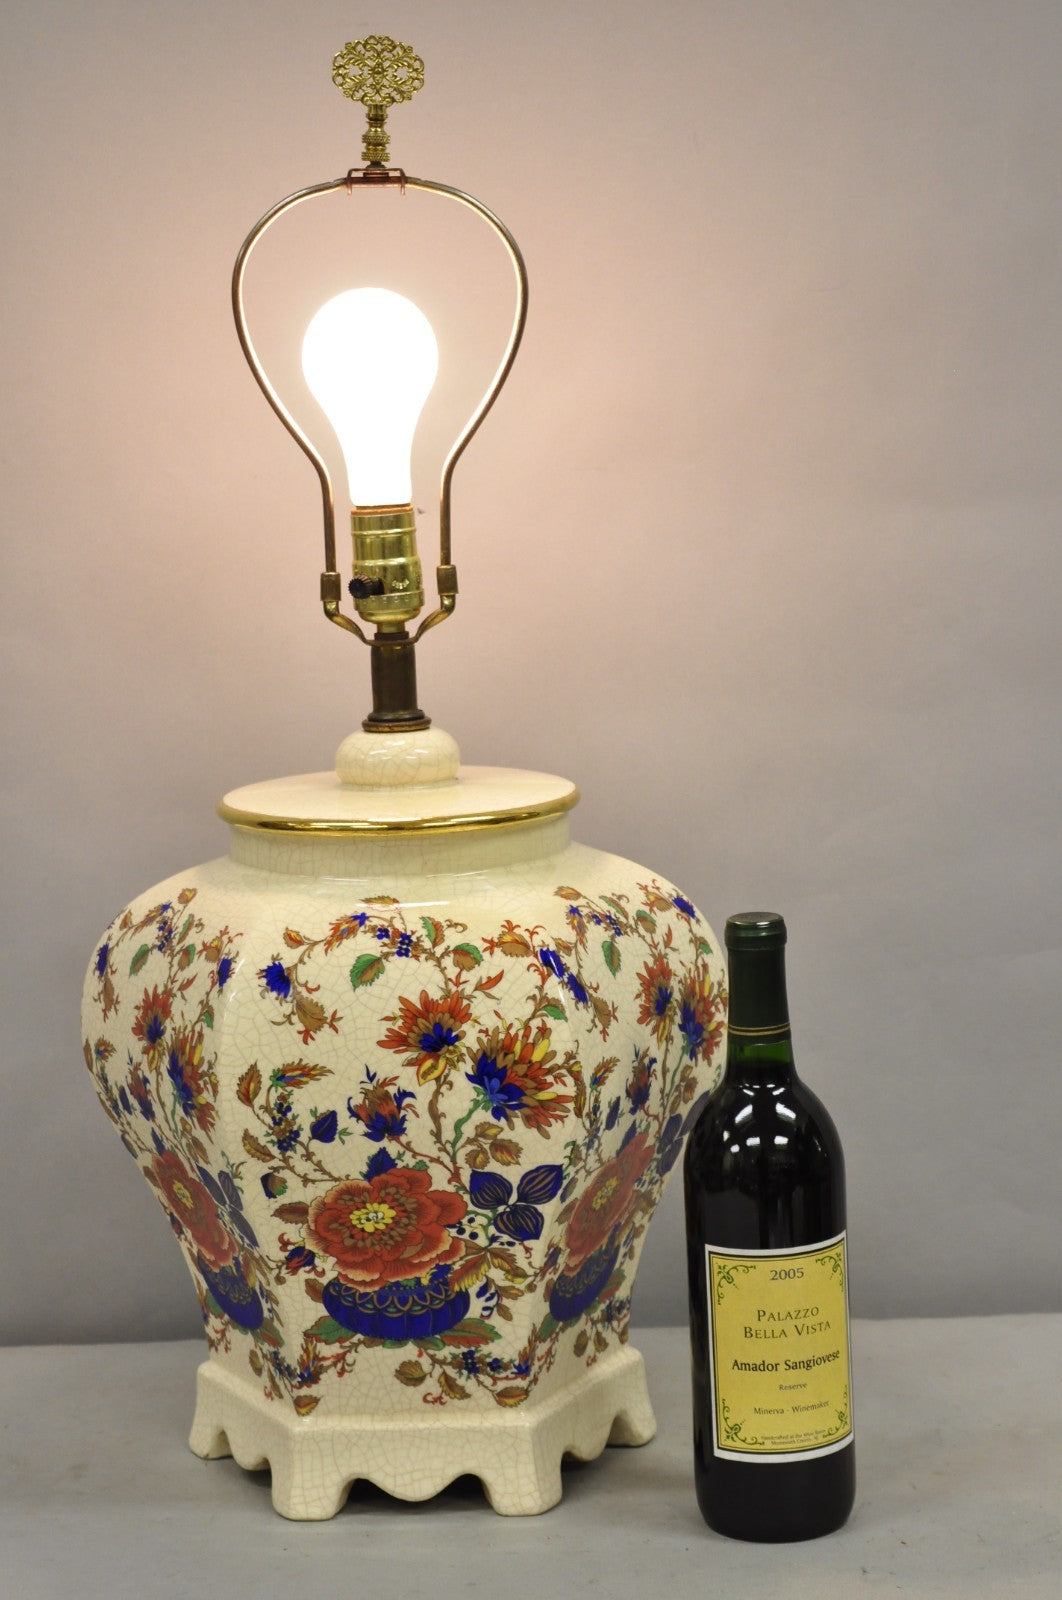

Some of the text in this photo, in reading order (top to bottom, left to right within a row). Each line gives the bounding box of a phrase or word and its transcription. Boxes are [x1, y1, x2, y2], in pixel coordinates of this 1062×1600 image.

[770, 1268, 804, 1281] 2005
[757, 1306, 819, 1322] PALAZZO
[744, 1321, 831, 1339] BELLA VISTA
[732, 1350, 840, 1372] Amador Sangiovese
[779, 1383, 808, 1391] Reserve
[753, 1407, 785, 1415] Minerva
[791, 1400, 830, 1413] Winemaker
